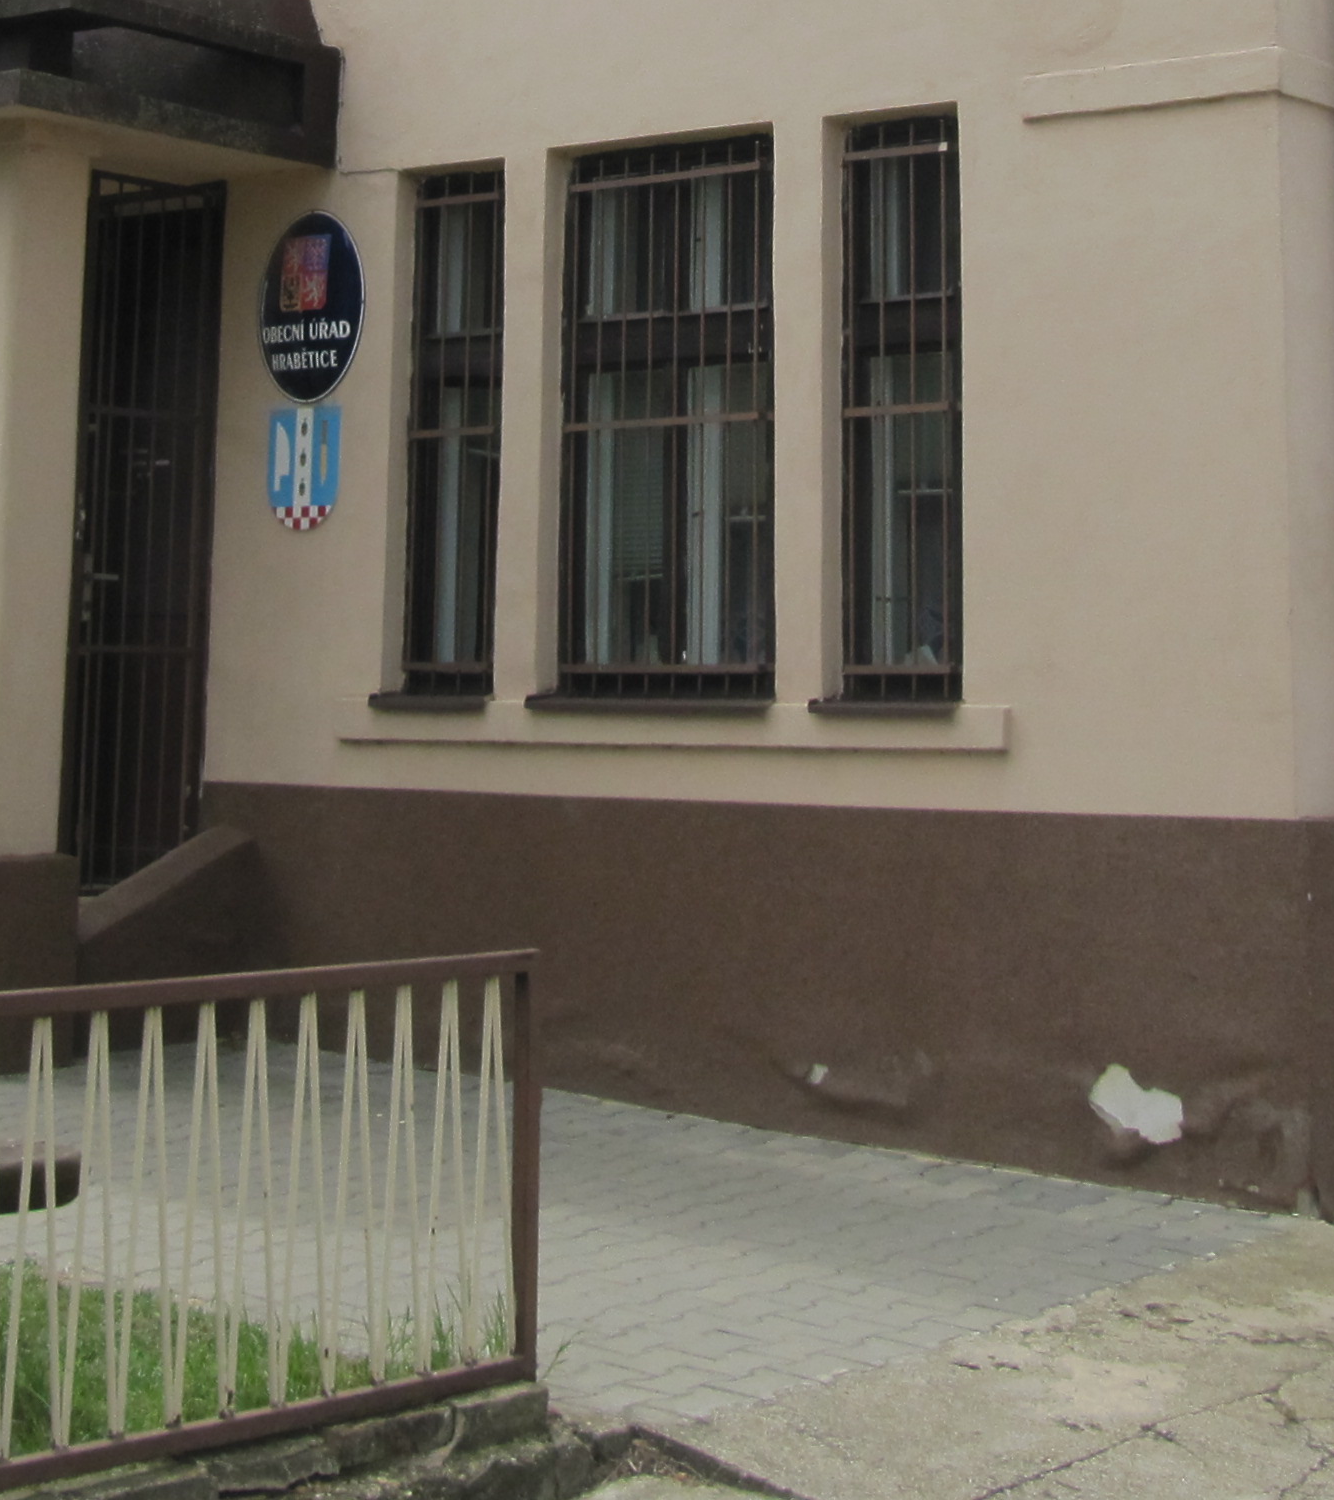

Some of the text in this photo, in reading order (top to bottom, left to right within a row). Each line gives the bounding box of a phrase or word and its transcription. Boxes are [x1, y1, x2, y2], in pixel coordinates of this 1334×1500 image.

[263, 318, 351, 343] OBECNÍ ÚŘAD
[271, 347, 338, 371] HRABĚTICE
